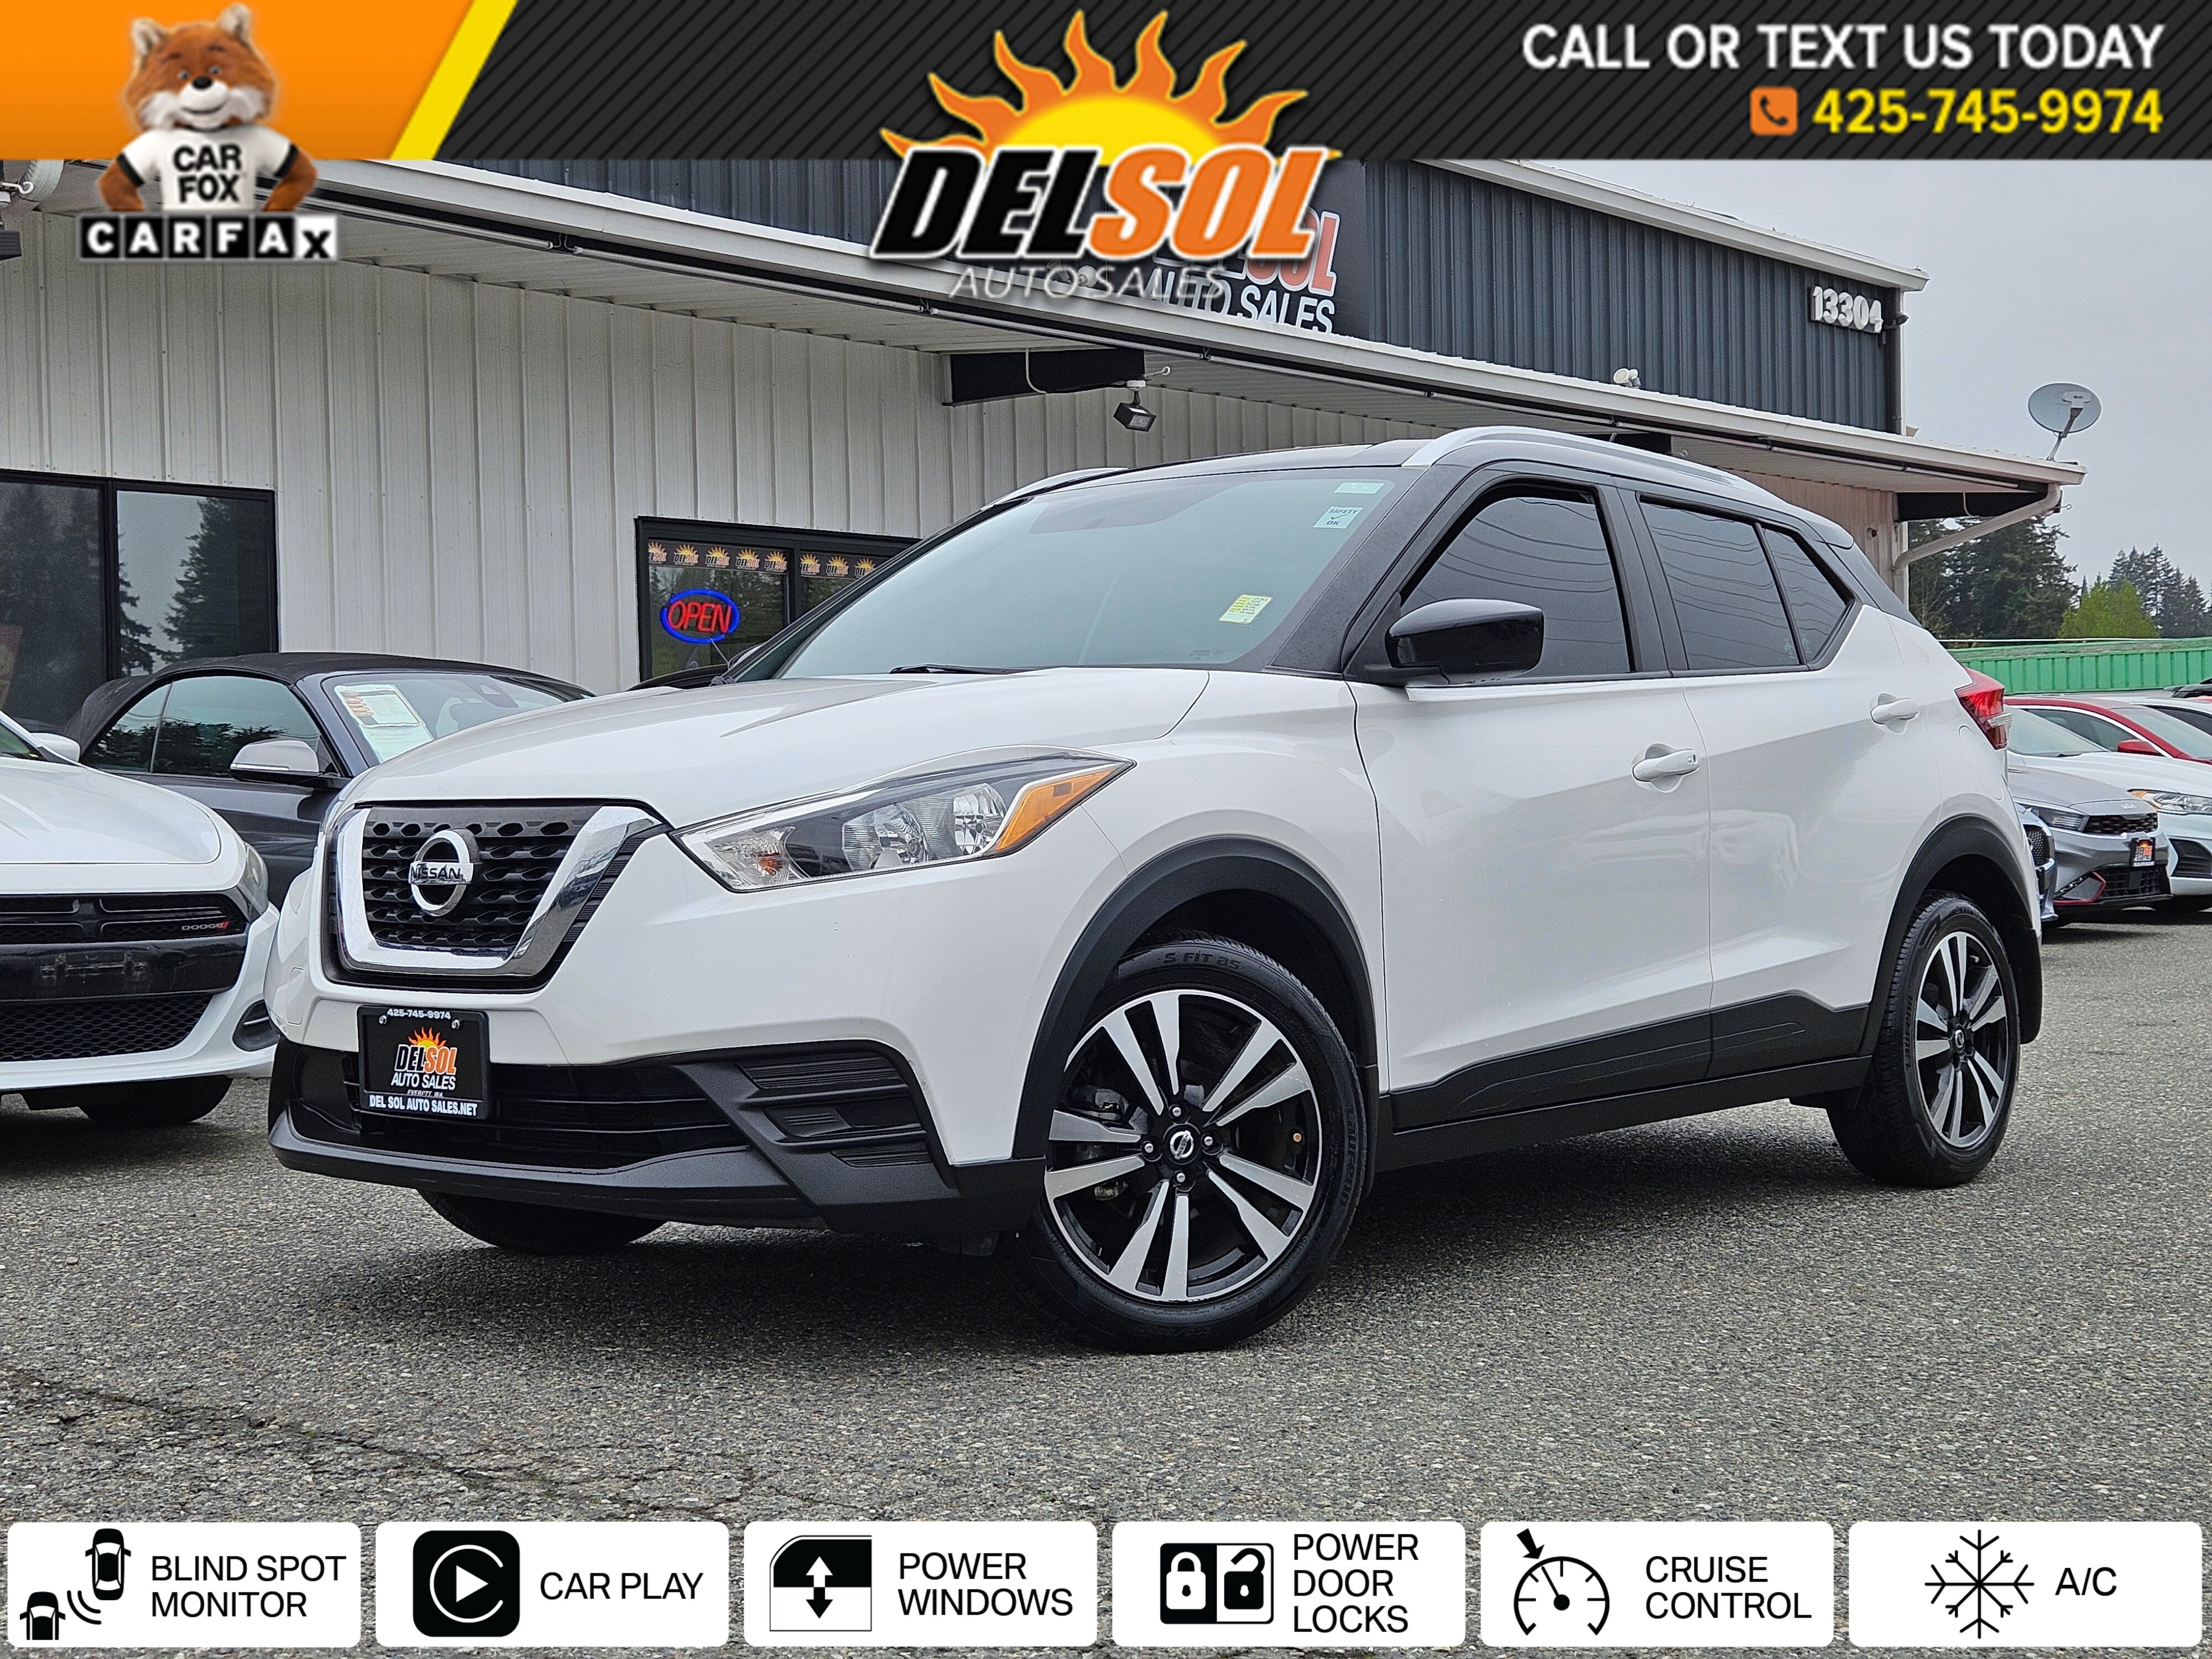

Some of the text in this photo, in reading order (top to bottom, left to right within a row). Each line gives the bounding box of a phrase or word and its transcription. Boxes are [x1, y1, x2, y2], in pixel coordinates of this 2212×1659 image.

[1240, 285, 1335, 333] SALES
[1813, 286, 1884, 333] 13304
[667, 600, 733, 633] OPEN
[411, 865, 461, 879] NISSAN
[1163, 952, 1177, 964] S
[387, 1008, 451, 1019] 425-745-9974
[391, 1072, 456, 1090] AUTO SALES
[369, 1094, 478, 1116] DEL SOL AUTO SALES.NET
